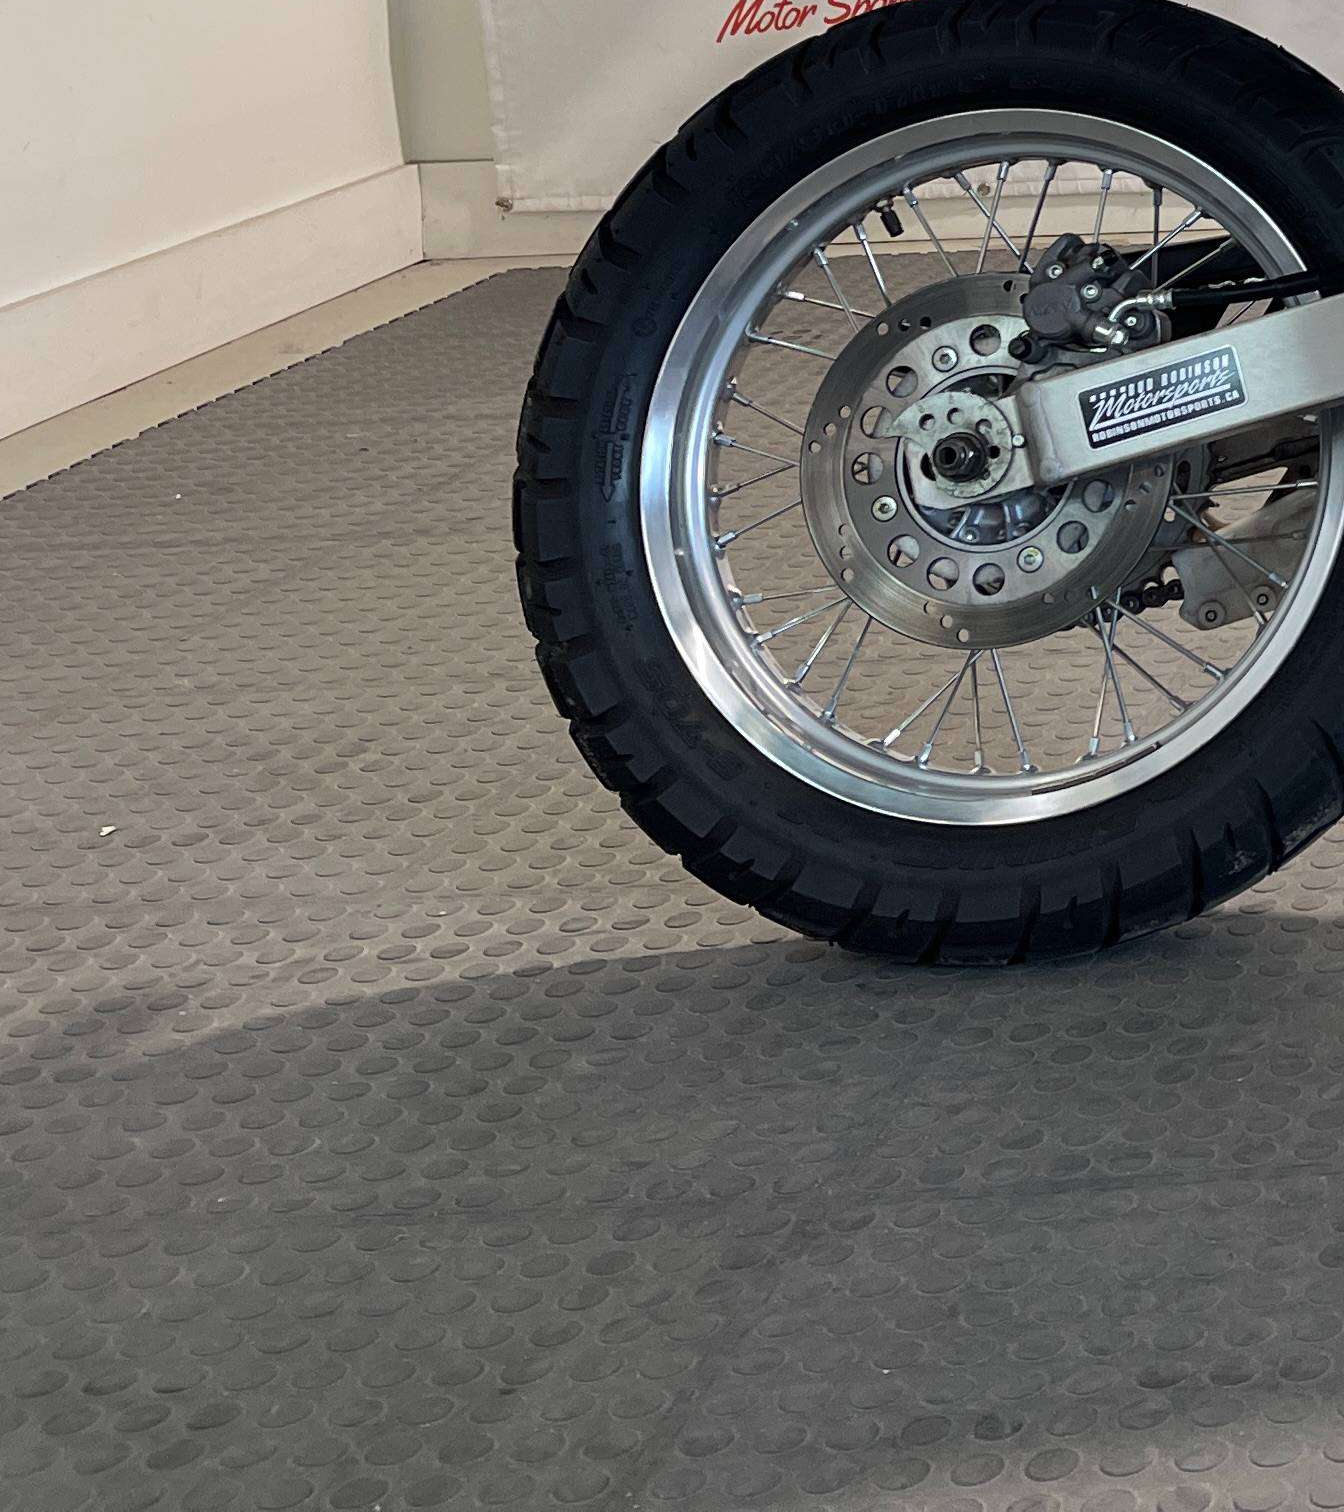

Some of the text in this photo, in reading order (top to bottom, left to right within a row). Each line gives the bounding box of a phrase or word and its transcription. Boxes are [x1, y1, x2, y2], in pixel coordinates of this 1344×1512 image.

[1160, 354, 1230, 387] ROBINSON
[1089, 368, 1236, 428] Motorsports
[1091, 389, 1240, 443] ROBINSONMOTORSPORTS.CA
